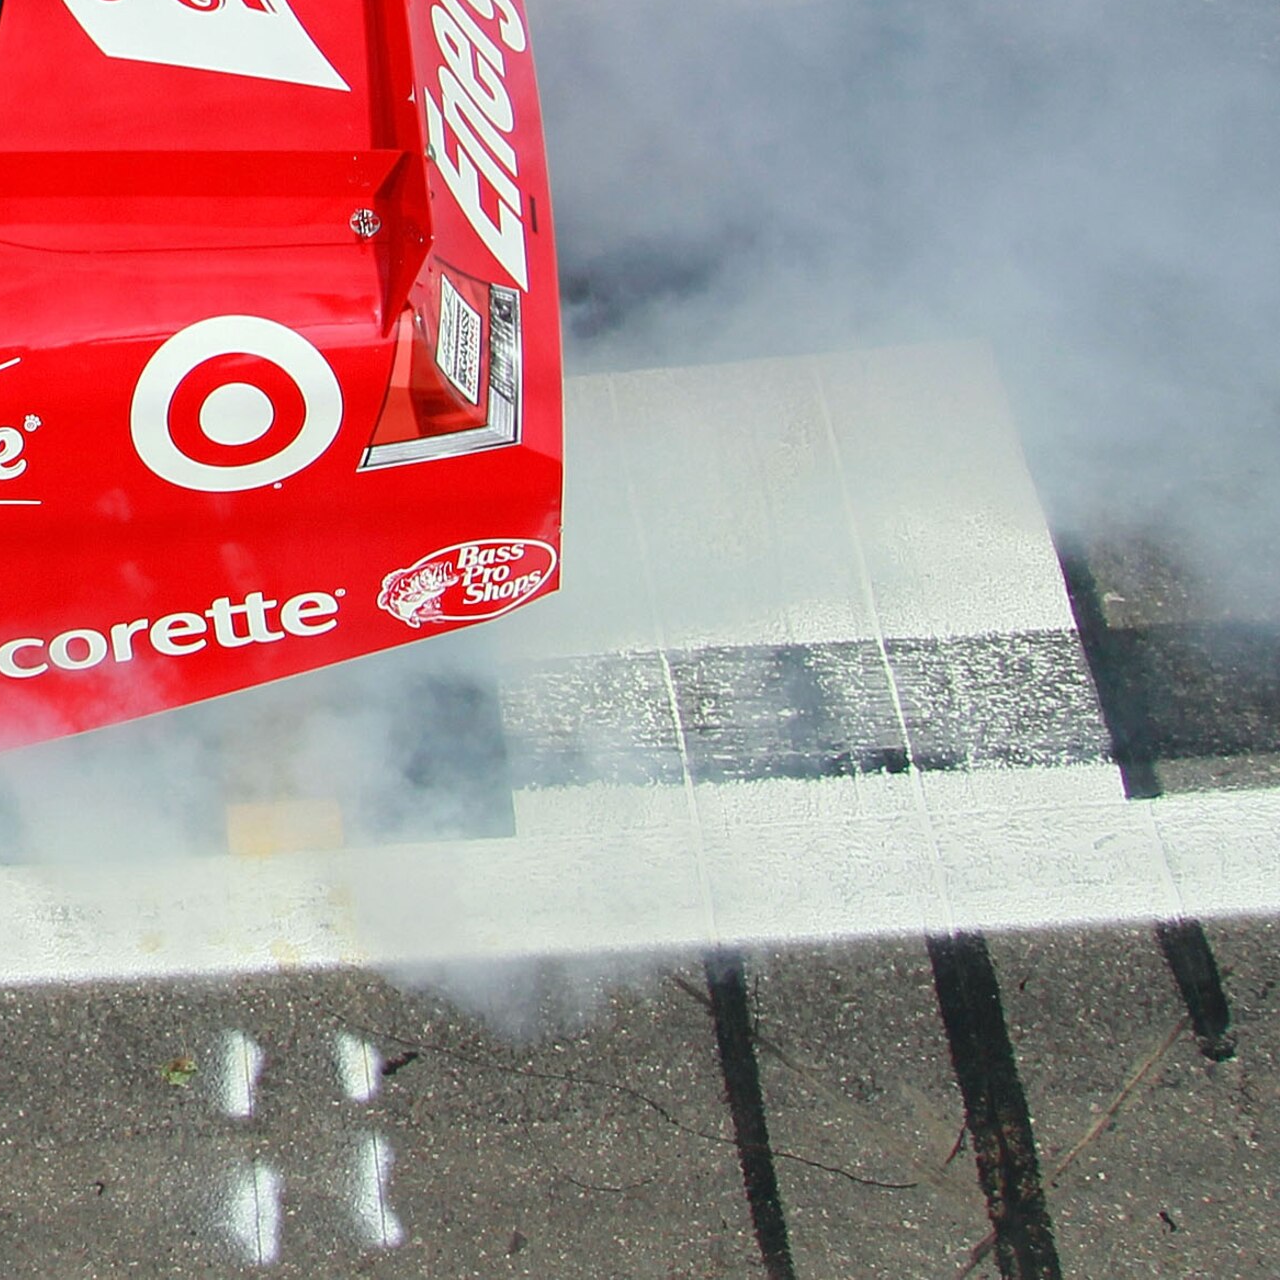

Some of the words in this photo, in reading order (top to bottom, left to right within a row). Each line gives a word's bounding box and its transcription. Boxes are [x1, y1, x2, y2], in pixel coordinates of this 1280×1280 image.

[456, 543, 525, 569] Bass
[462, 565, 510, 588] Pro
[463, 569, 542, 605] Shops
